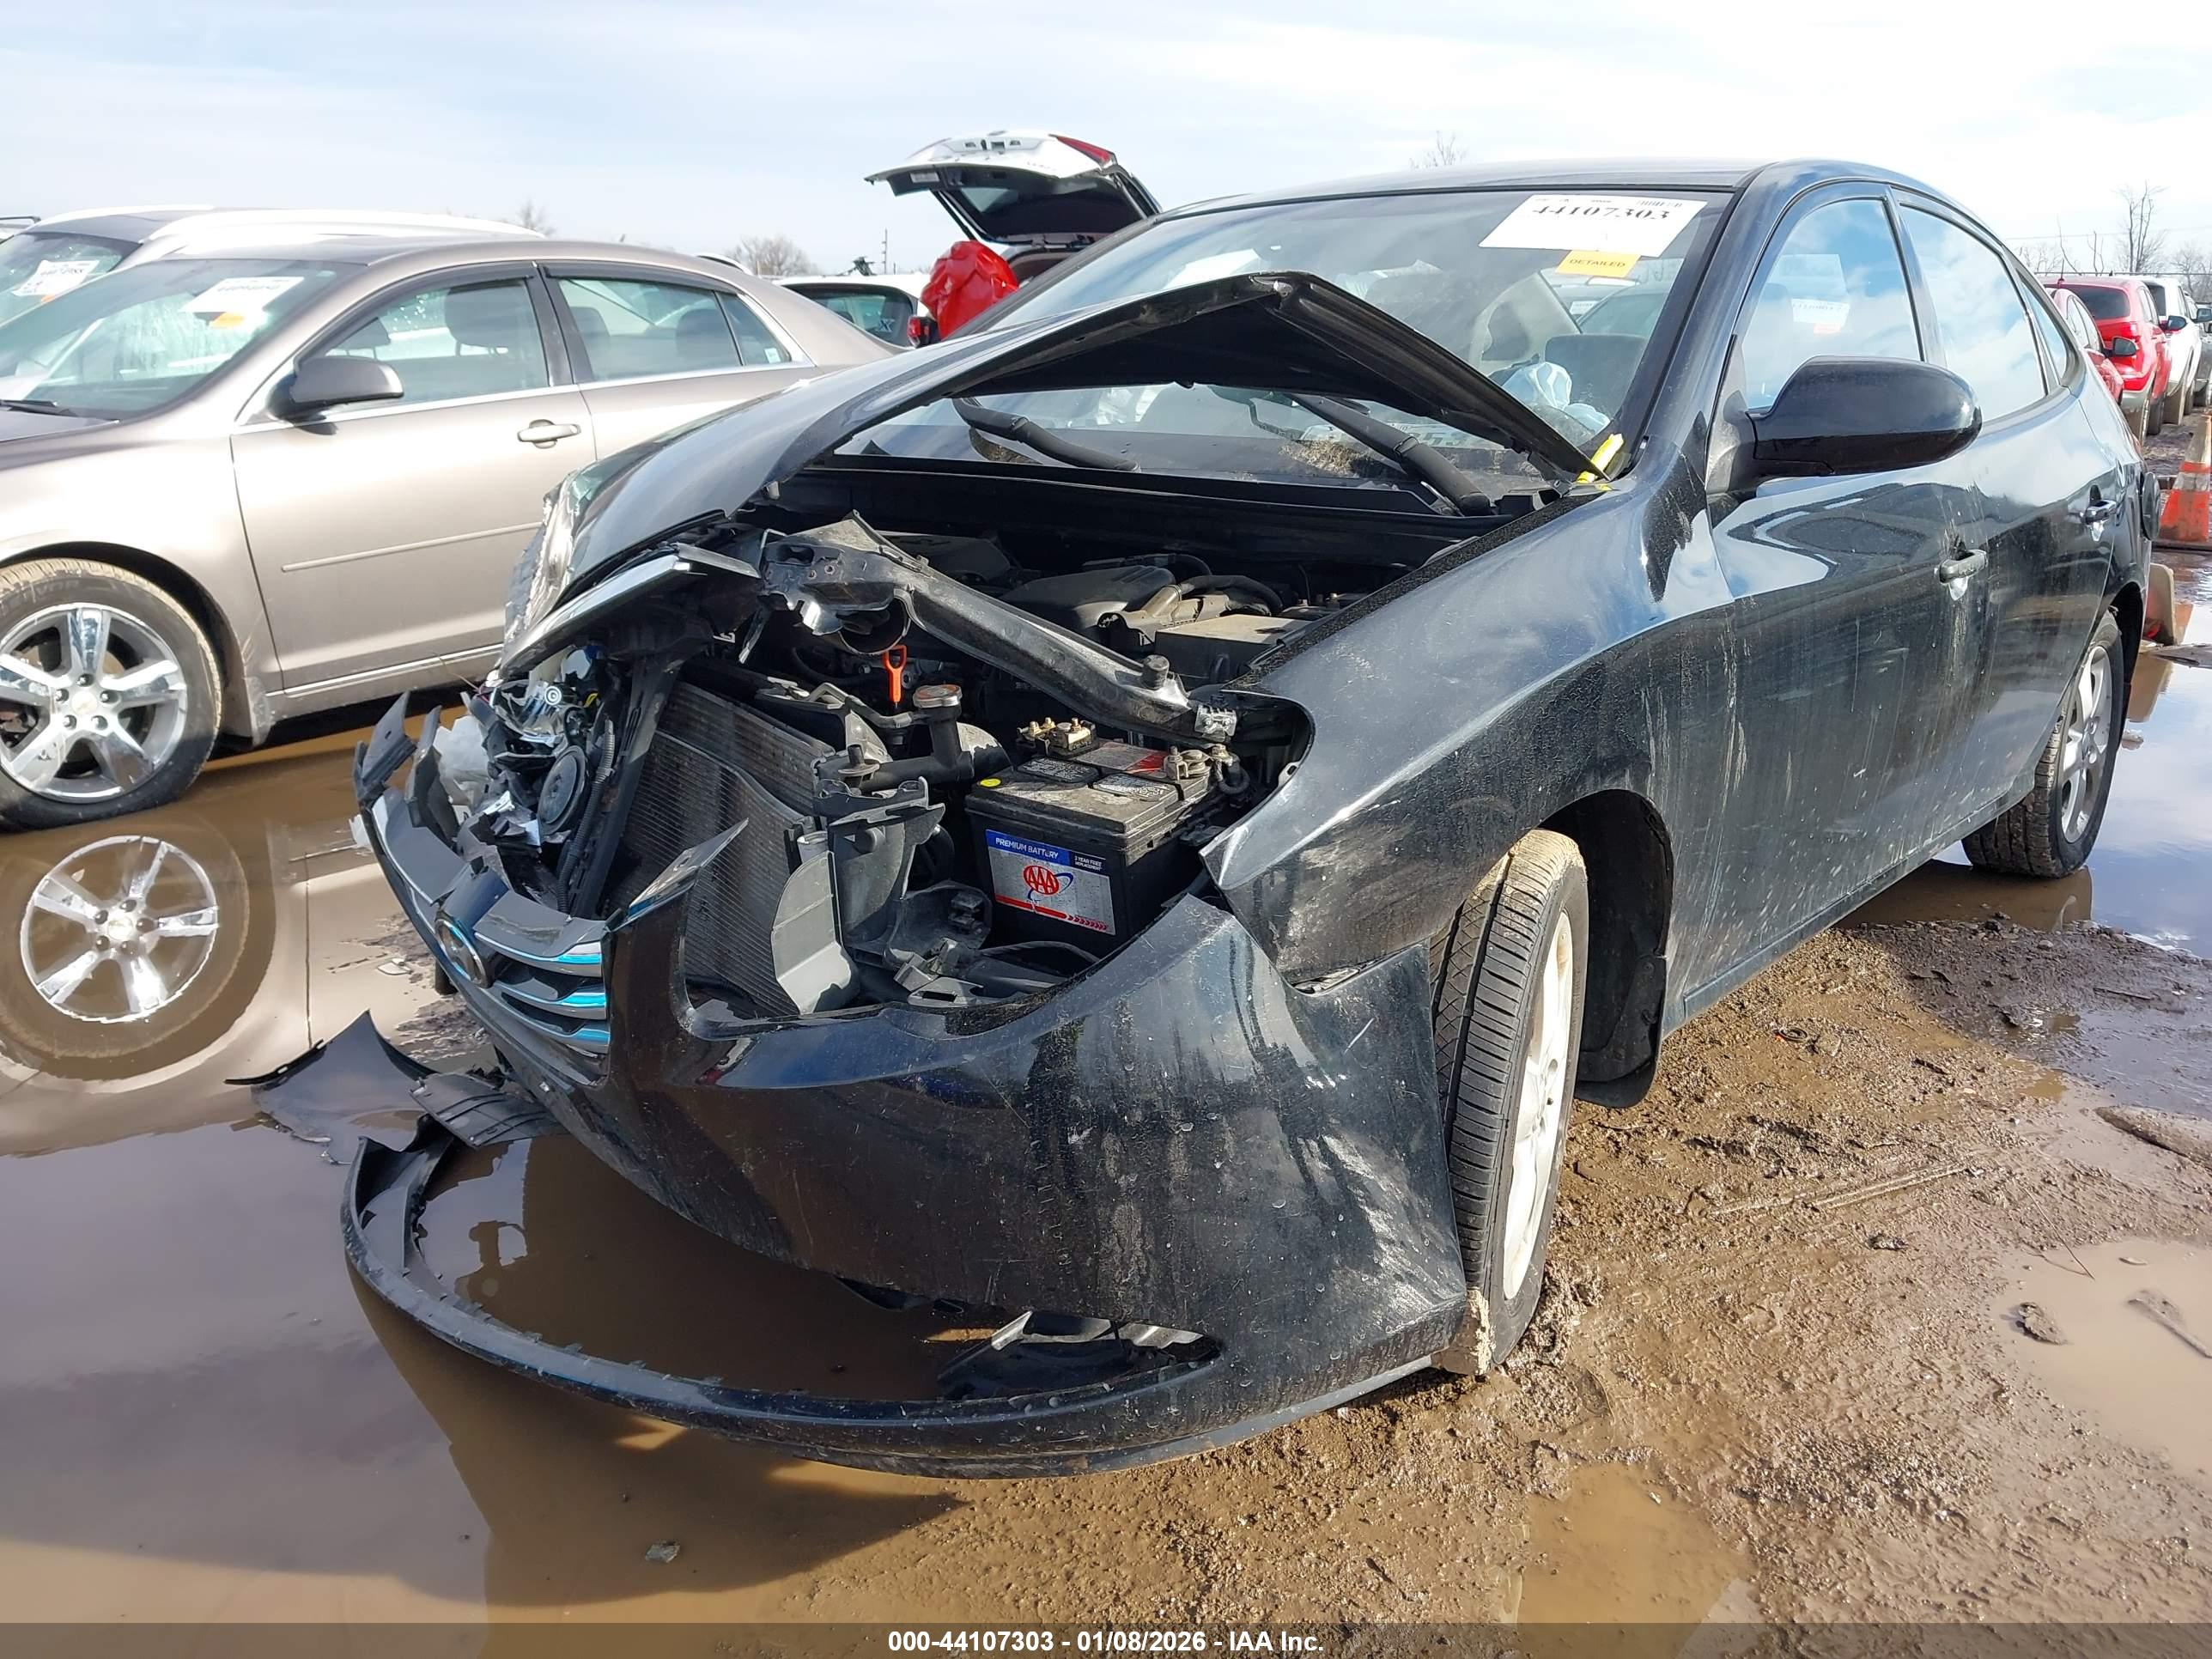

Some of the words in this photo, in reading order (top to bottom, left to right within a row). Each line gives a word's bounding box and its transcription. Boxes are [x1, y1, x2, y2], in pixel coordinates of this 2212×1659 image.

[1532, 205, 1670, 220] 44107303
[1569, 258, 1626, 268] DETAILED
[995, 837, 1027, 852] PREMIUM
[1028, 846, 1059, 860] BATTERY
[1025, 866, 1058, 894] AAA
